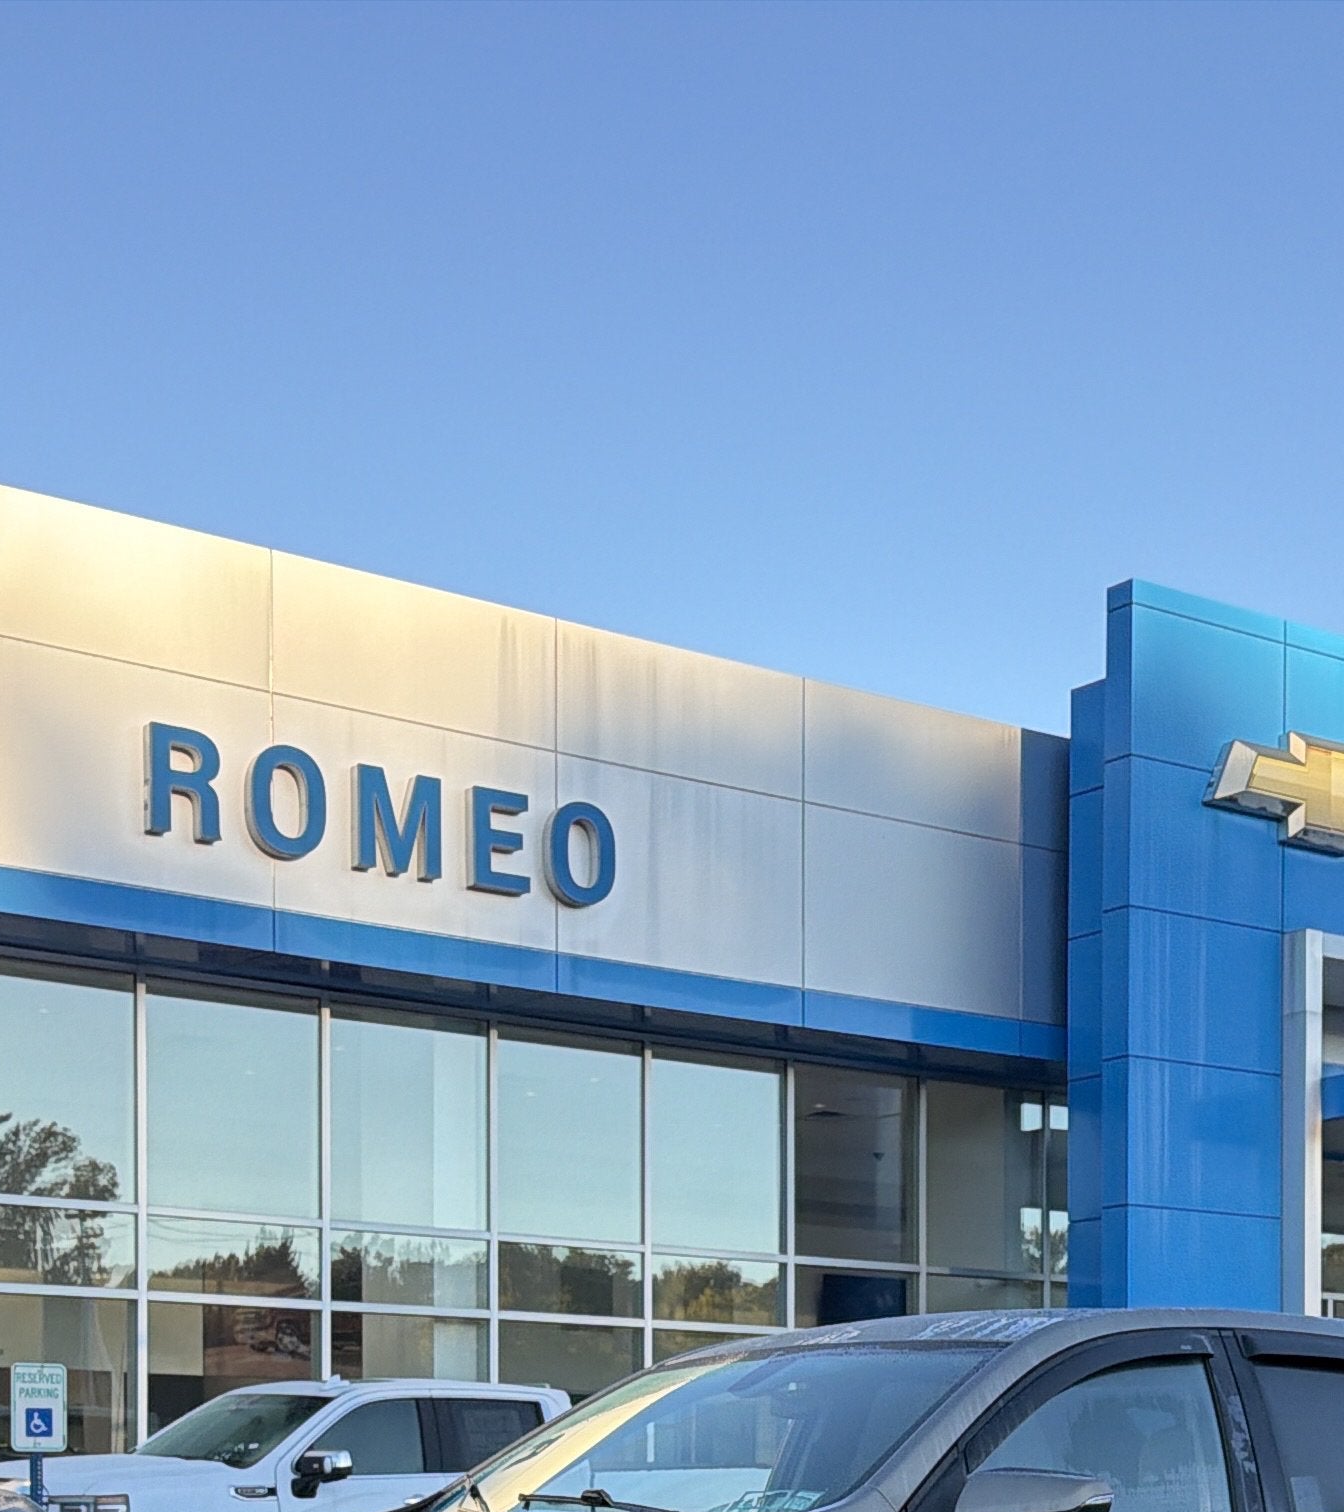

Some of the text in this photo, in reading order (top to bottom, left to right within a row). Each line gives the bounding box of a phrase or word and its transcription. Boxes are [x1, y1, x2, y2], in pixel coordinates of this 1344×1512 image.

[144, 721, 616, 908] ROMEO
[15, 1372, 62, 1385] RESERVED
[18, 1387, 59, 1399] PARKING
